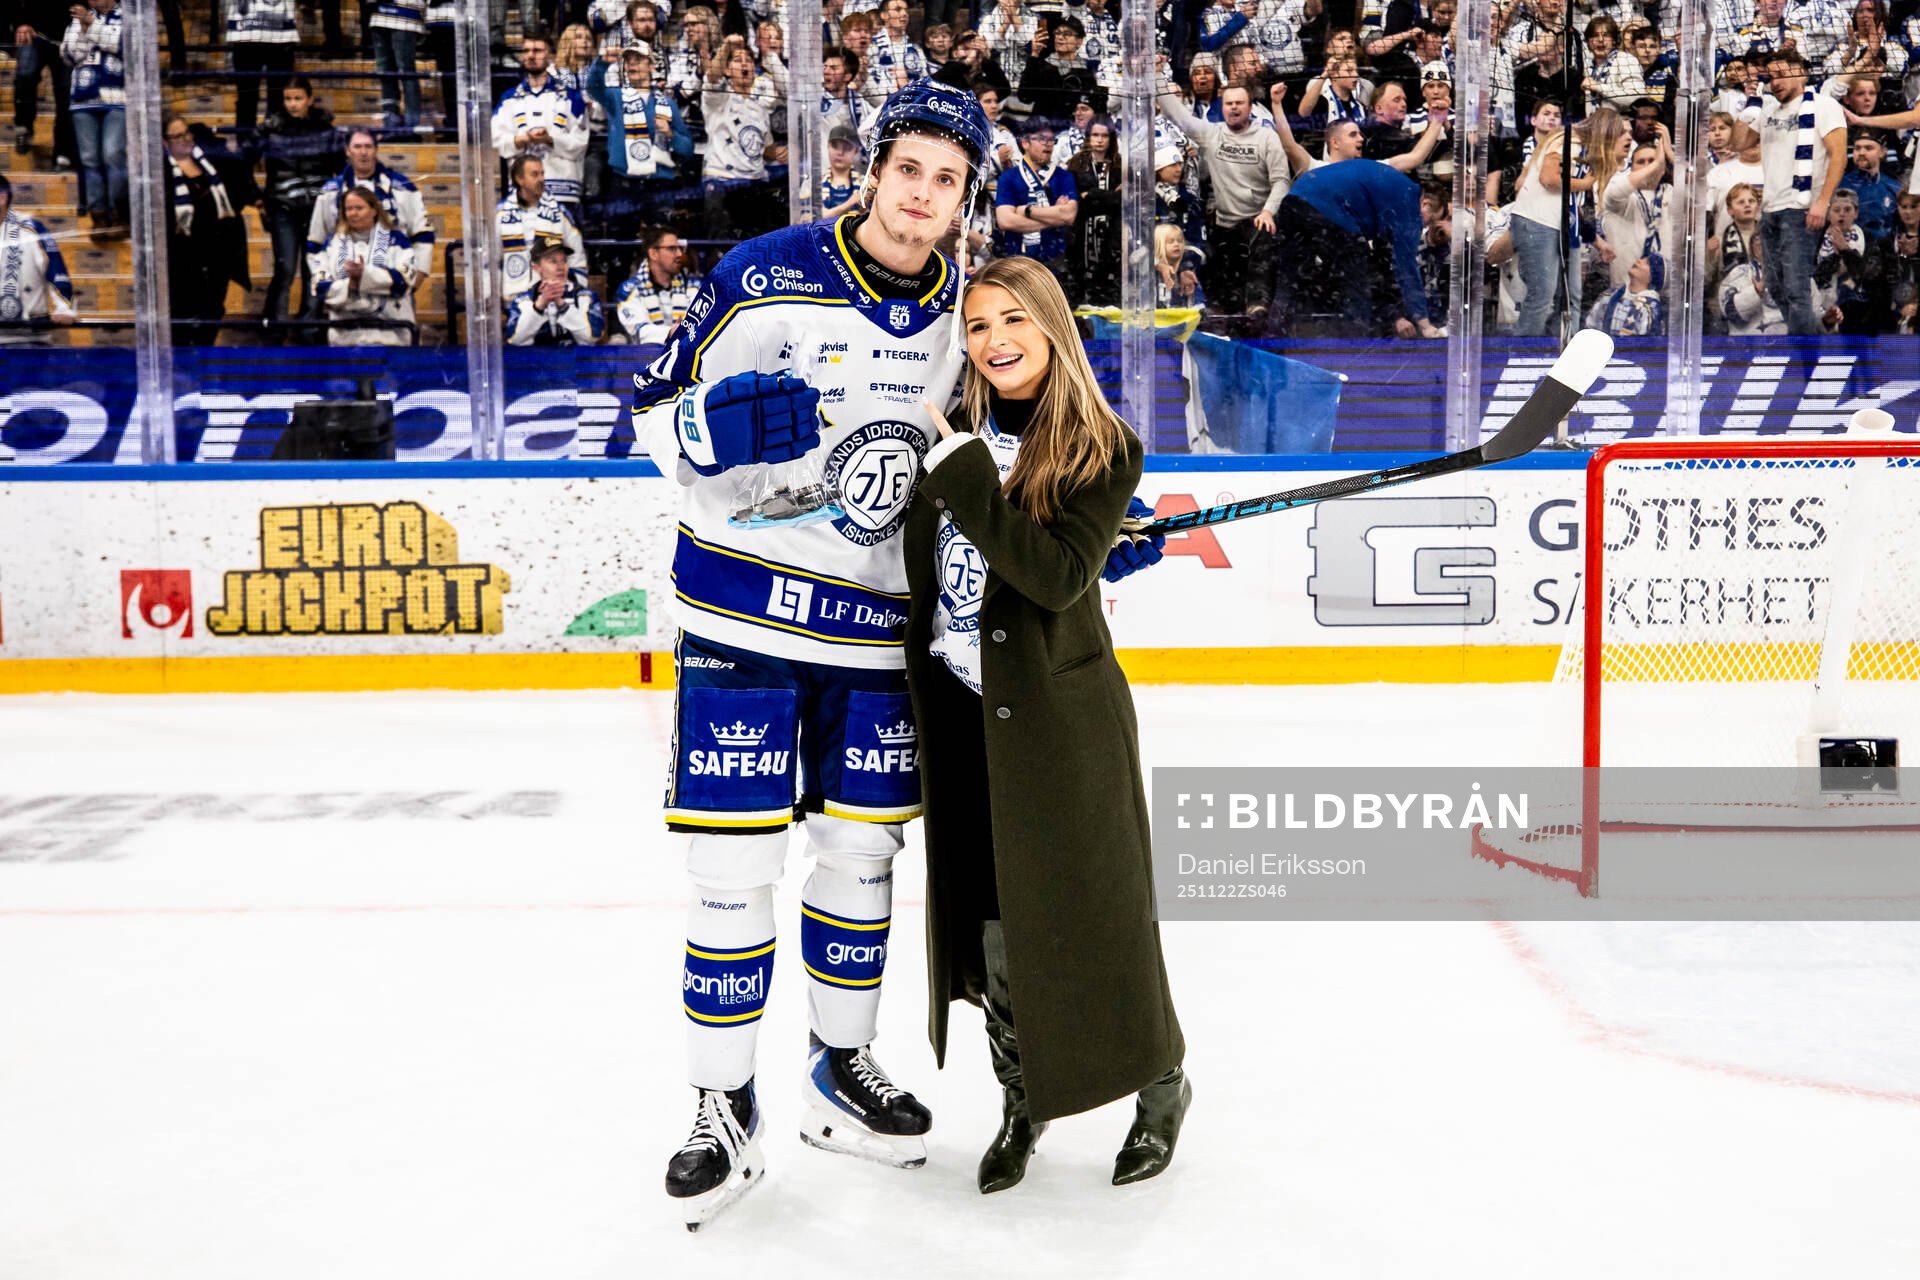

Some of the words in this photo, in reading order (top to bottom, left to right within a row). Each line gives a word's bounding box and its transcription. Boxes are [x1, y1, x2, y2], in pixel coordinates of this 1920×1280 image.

[770, 265, 804, 280] Clas
[829, 255, 855, 291] TEGERA
[864, 263, 921, 289] BAUER
[773, 276, 823, 294] Ohlson
[889, 304, 910, 314] SHL
[889, 313, 910, 327] 50
[819, 342, 848, 357] gkvist
[884, 350, 928, 362] TEGERA
[0, 388, 622, 464] ompa
[998, 436, 1015, 445] SHL
[824, 433, 865, 492] KSANDS
[260, 502, 428, 568] EURO
[841, 516, 900, 546] ISHOCKEY
[206, 564, 491, 634] JACKPOT
[819, 597, 851, 621] LF
[683, 656, 736, 670] BAUER
[688, 749, 790, 777] SAFE4U
[707, 901, 747, 911] BAUER
[826, 938, 888, 965] grani
[719, 992, 759, 1005] ELECTRO
